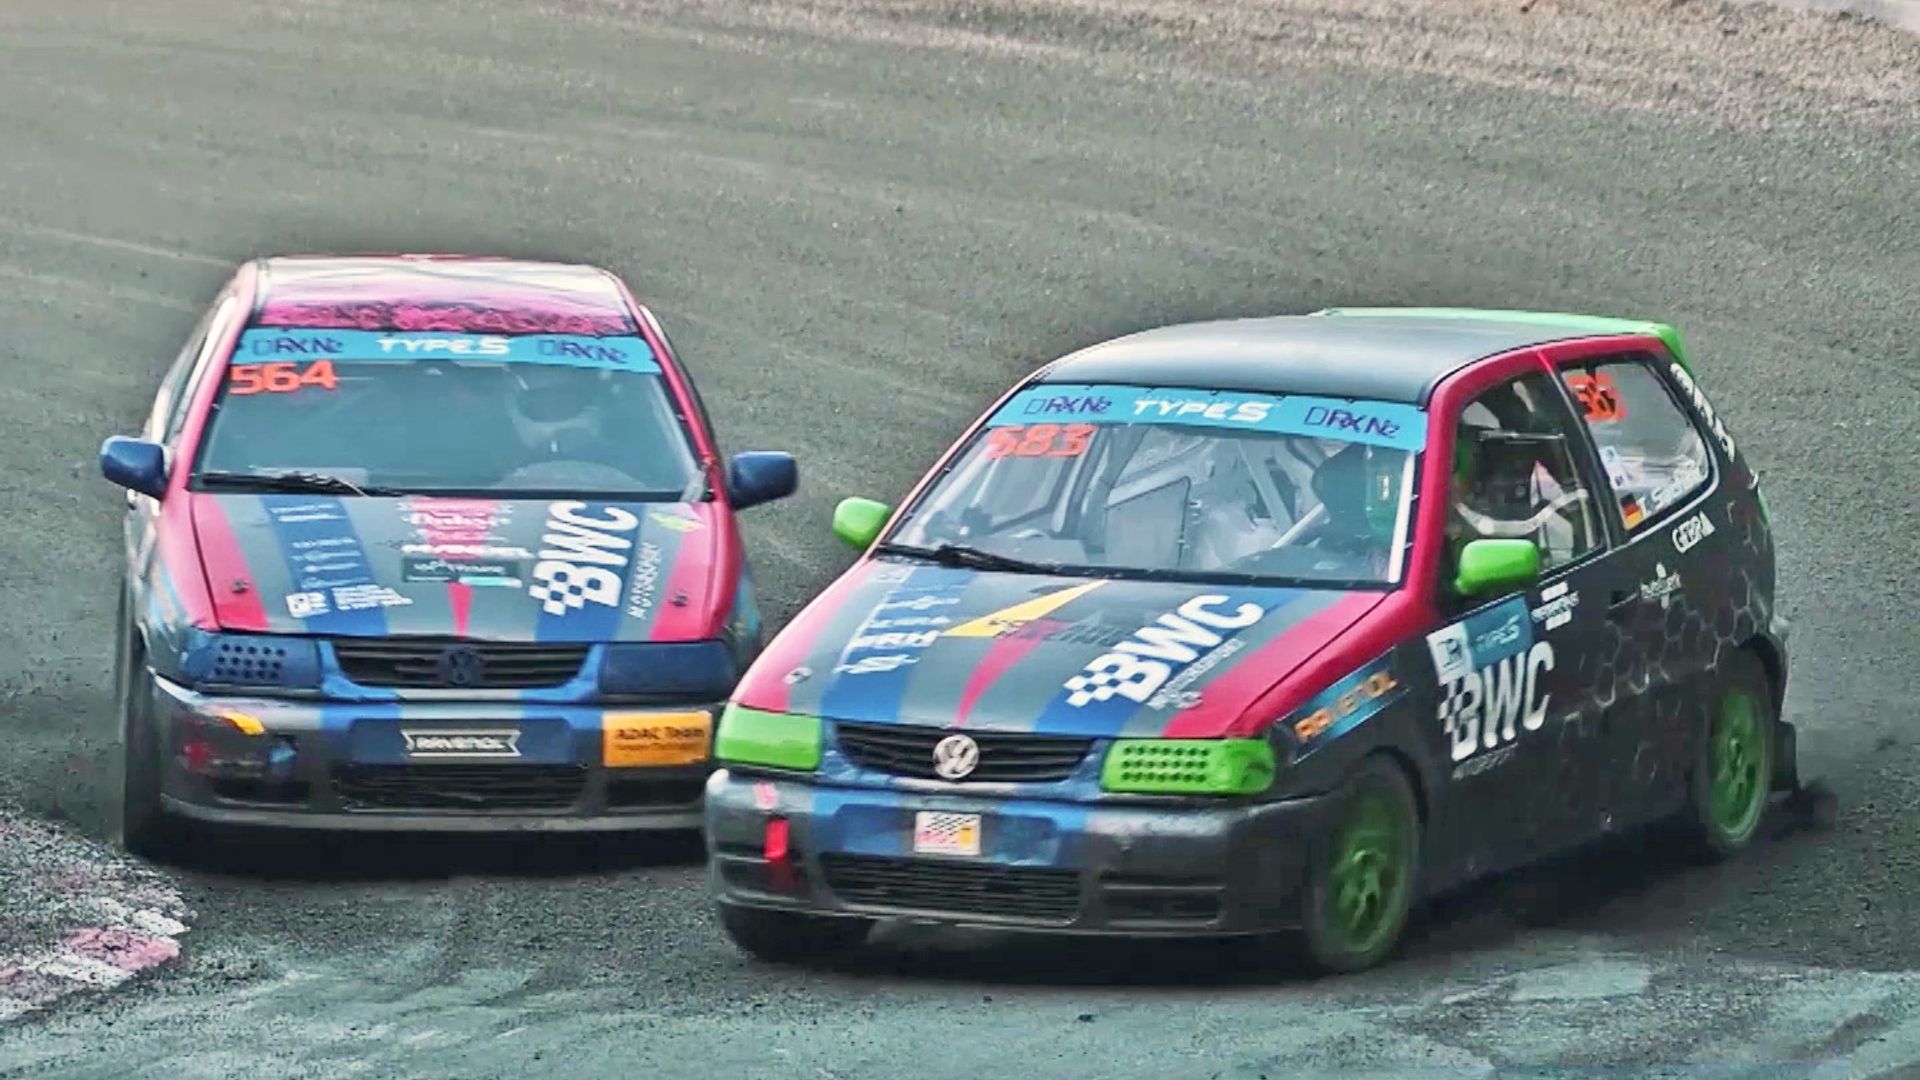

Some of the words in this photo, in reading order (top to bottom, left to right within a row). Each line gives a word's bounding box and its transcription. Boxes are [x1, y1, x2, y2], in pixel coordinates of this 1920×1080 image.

[229, 359, 338, 395] 564
[984, 424, 1096, 459] 583
[529, 501, 639, 617] BWC
[1064, 594, 1264, 708] BWC
[1438, 641, 1555, 762] BWC
